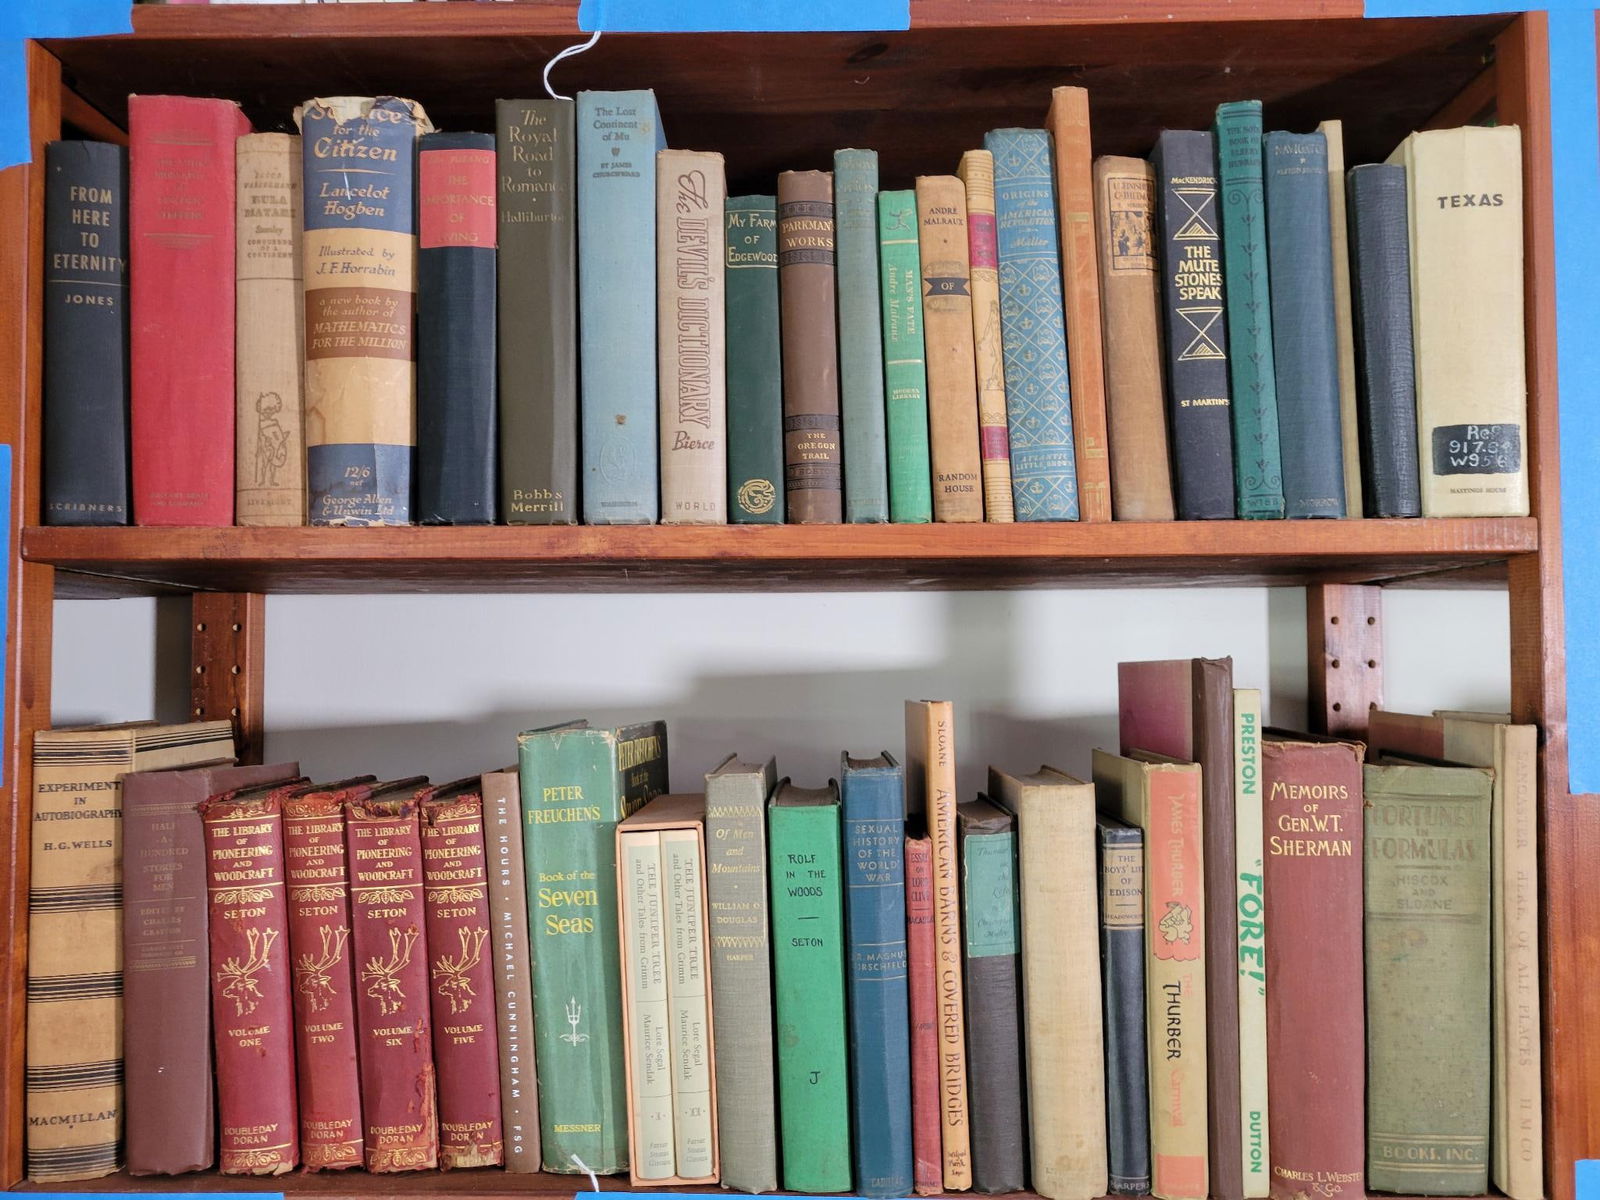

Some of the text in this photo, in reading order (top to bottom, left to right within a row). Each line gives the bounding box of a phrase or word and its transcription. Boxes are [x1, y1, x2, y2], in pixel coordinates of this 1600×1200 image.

[521, 109, 547, 126] The
[595, 107, 636, 116] The Lost
[593, 120, 638, 129] Continent
[510, 126, 558, 146] Royal
[314, 137, 397, 161] Citizen
[513, 146, 553, 162] Road
[528, 167, 542, 177] to
[70, 186, 112, 204] FROM
[320, 183, 390, 199] Lancelot
[1002, 190, 1049, 201] ORIGINS
[1437, 194, 1504, 209] TEXAS
[325, 200, 384, 220] Hogben
[72, 209, 110, 227] HERE
[923, 218, 964, 226] MALRAUX
[81, 232, 99, 248] TO
[744, 236, 760, 244] OF
[786, 238, 833, 248] WORKS
[319, 246, 395, 260] Illustrated by
[1184, 246, 1211, 258] THE
[53, 253, 126, 273] ETERNITY
[1179, 260, 1219, 273] MUTE
[941, 282, 955, 291] OF
[1175, 274, 1223, 287] STONES
[676, 170, 715, 428] The DEVIL'S DICTIONARY
[1180, 287, 1222, 300] SPEAK
[65, 294, 114, 306] JONES
[355, 295, 399, 307] book by
[343, 306, 379, 315] author
[313, 321, 406, 335] MATHEMATICS
[312, 337, 407, 350] FOR THE MILLION
[672, 431, 715, 452] Bierce
[797, 442, 835, 450] OREGON
[802, 453, 830, 461] TRAIL
[344, 465, 371, 478] 12/6
[938, 472, 977, 482] RANDOM
[513, 489, 563, 500] Bobbs
[945, 484, 974, 493] HOUSE
[323, 494, 362, 507] George
[675, 501, 716, 511] WORLD
[49, 503, 122, 512] SCRIBNERS
[334, 506, 372, 515] Unwin
[511, 502, 564, 513] Merrill
[937, 720, 946, 767] SLOANE
[1241, 713, 1256, 794] PRESTON
[38, 781, 121, 793] EXPERIMENT
[1271, 782, 1348, 801] MEMOIRS
[543, 786, 584, 802] PETER
[74, 797, 86, 805] IN
[528, 804, 601, 824] FREUCHEN'S
[1303, 804, 1319, 812] OF
[34, 810, 123, 821] AUTOBIOGRAPHY
[212, 823, 274, 838] THE LIBRARY
[288, 822, 345, 835] THE LIBRARY
[355, 825, 412, 838] THE LIBRARY
[442, 824, 480, 836] LIBRARY
[716, 828, 729, 840] Of
[855, 824, 898, 834] SEXUAL
[936, 788, 953, 879] AMERICAN
[309, 836, 320, 844] OF
[378, 838, 389, 846] OF
[853, 836, 899, 846] HISTORY
[1270, 836, 1352, 856] SHERMAN
[212, 845, 274, 860] PIONEERING
[288, 844, 345, 858] PIONEERING
[356, 848, 412, 860] PIONEERING
[424, 847, 481, 860] PIONEERING
[726, 846, 744, 856] and
[858, 850, 896, 859] OF THE
[233, 860, 252, 868] AND
[443, 860, 462, 868] AND
[788, 854, 816, 864] ROLF
[291, 867, 345, 879] WOODCRAFT
[426, 867, 482, 881] WOODCRAFT
[712, 863, 761, 873] Mountains
[808, 870, 826, 878] THE
[214, 868, 274, 881] WOODCRAFT
[358, 869, 414, 881] WOODCRAFT
[539, 870, 576, 882] Book of
[865, 873, 891, 882] WAR
[1396, 875, 1448, 886] HISCOX
[538, 888, 598, 908] Seven
[788, 887, 823, 897] WOODS
[299, 905, 338, 916] SETON
[1397, 899, 1452, 910] SLOANE
[223, 907, 266, 919] SETON
[367, 907, 407, 919] SETON
[437, 907, 476, 918] SETON
[938, 887, 956, 945] BARNS
[545, 915, 594, 936] Seas
[792, 938, 823, 947] SETON
[497, 798, 523, 1154] THE HOURS MICHAEL CUNNINGHAM FSG
[942, 971, 960, 1044] COVERED
[304, 1023, 344, 1032] VOLUME
[1163, 983, 1181, 1061] THURBER
[373, 1026, 412, 1036] VOLUME
[444, 1025, 484, 1034] VOLUME
[239, 1037, 261, 1047] ONE
[311, 1034, 335, 1044] TWO
[386, 1037, 402, 1046] SIX
[453, 1036, 475, 1044] FIVE
[810, 1071, 821, 1084] J
[944, 1052, 963, 1127] BRIDGES
[28, 1110, 117, 1126] MACMILLAN
[224, 1123, 278, 1136] DOUBLEDAY
[303, 1119, 352, 1132] DOUBLEDAY
[370, 1123, 422, 1135] DOUBLEDAY
[442, 1121, 493, 1134] DOUBLEDAY
[554, 1124, 601, 1133] MESSNER
[233, 1134, 268, 1145] DORAN
[310, 1130, 344, 1140] DORAN
[379, 1134, 414, 1144] DORAN
[1250, 1111, 1262, 1173] DUTTON
[1446, 1147, 1479, 1160] INC.
